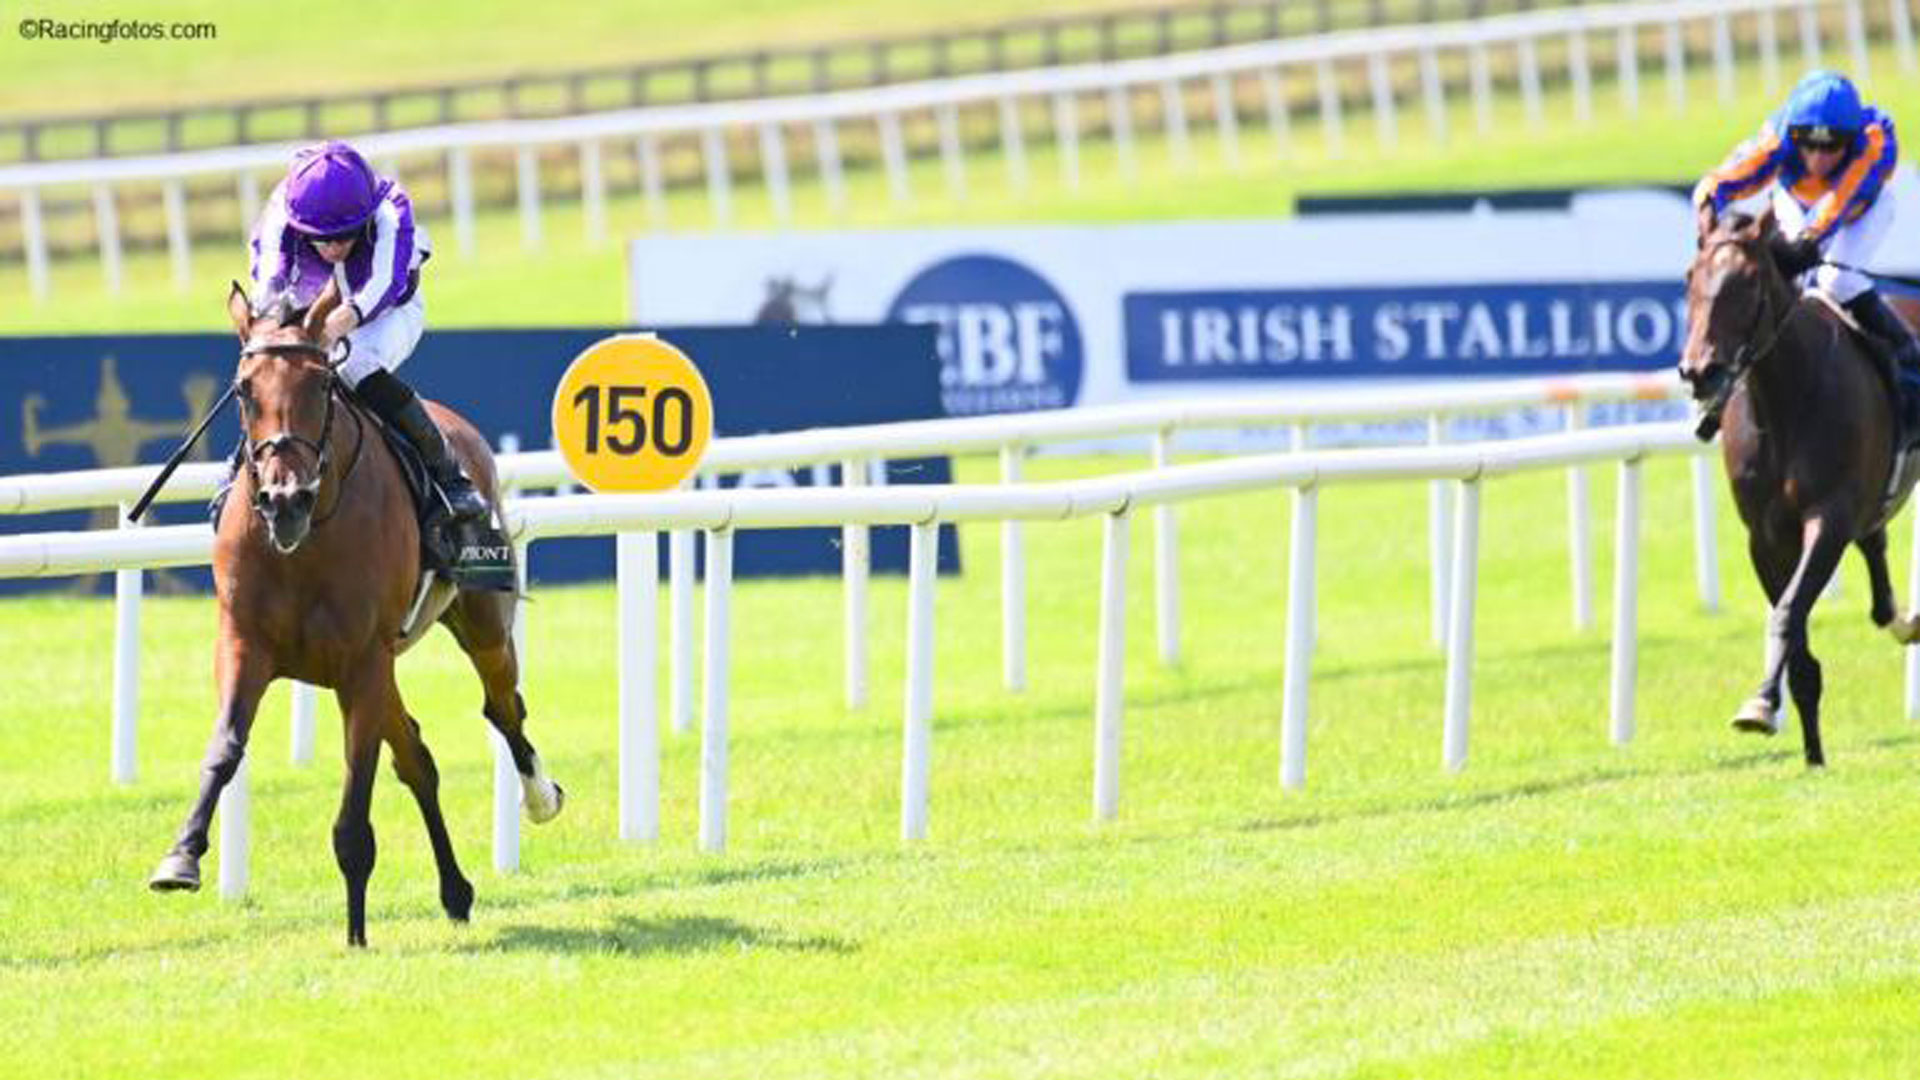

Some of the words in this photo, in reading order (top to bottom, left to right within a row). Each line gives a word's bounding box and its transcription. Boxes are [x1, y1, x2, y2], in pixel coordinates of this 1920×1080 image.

[1160, 303, 1354, 366] IRISH
[1374, 298, 1686, 361] STALLIO
[572, 385, 694, 458] 150
